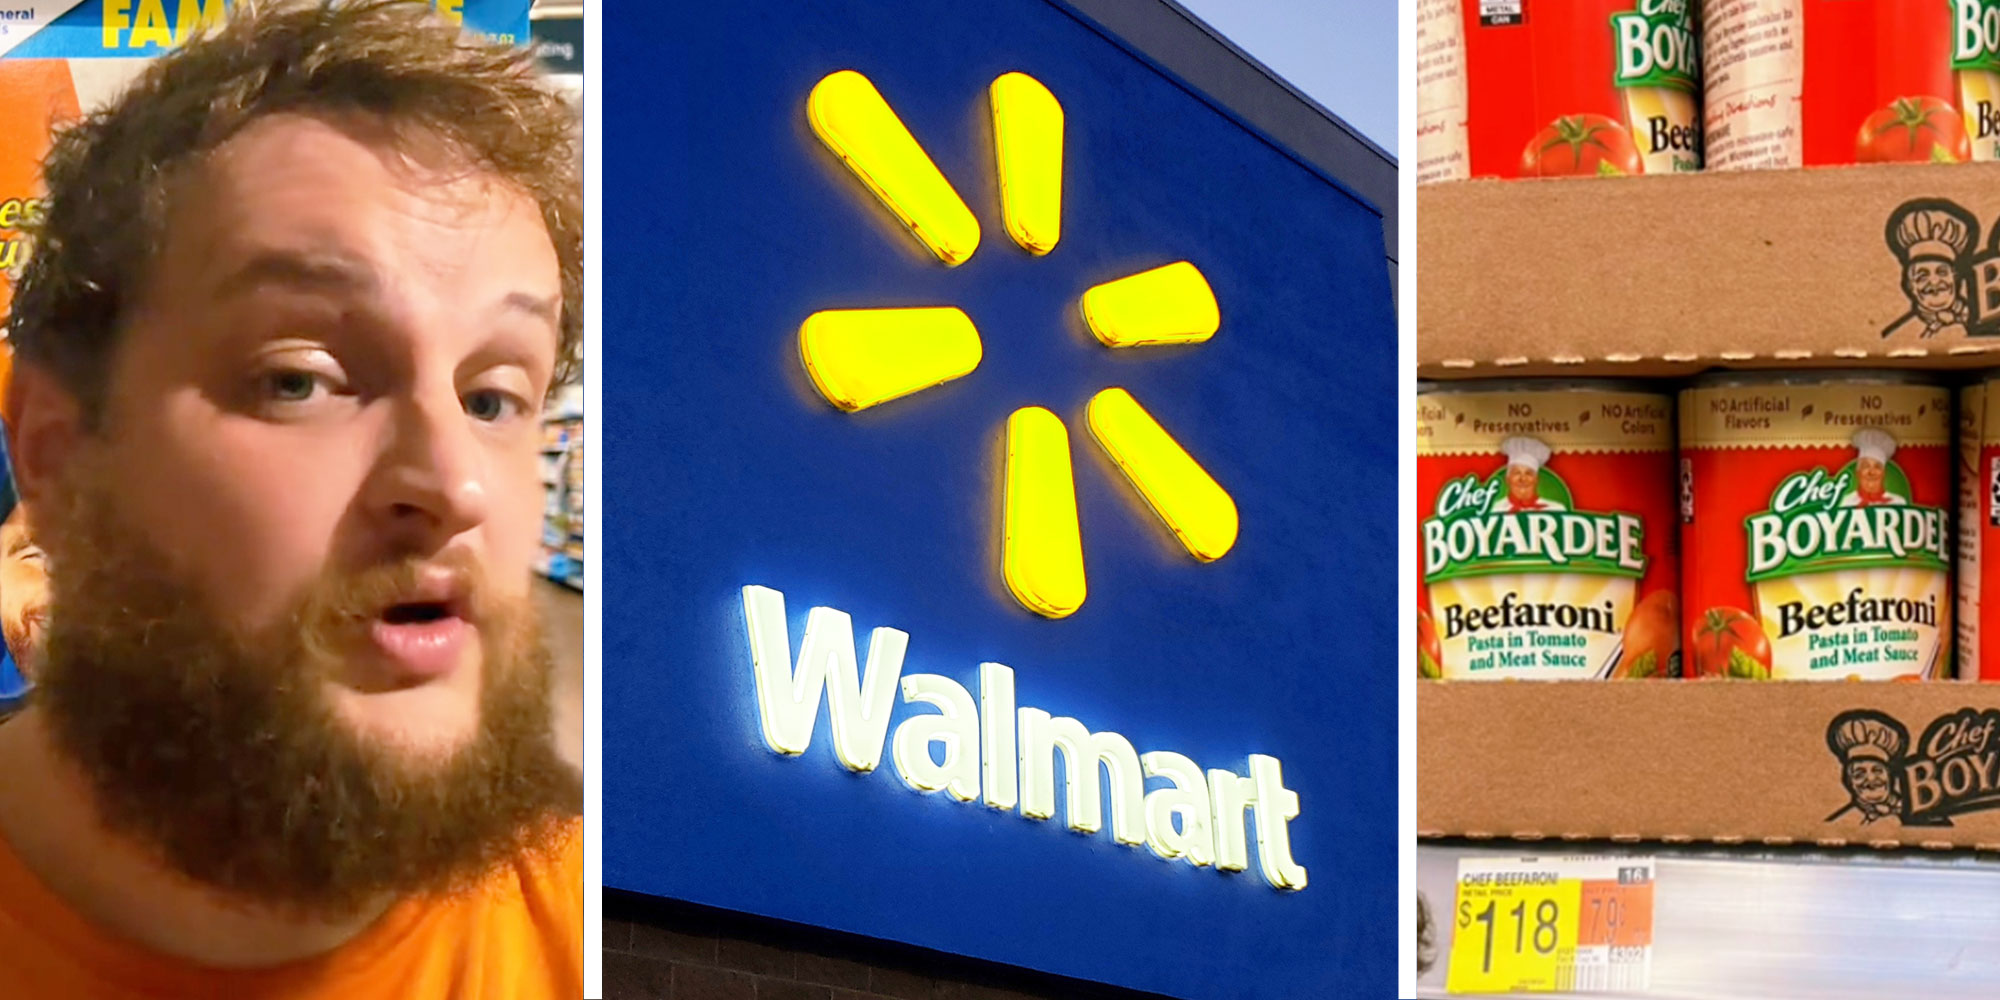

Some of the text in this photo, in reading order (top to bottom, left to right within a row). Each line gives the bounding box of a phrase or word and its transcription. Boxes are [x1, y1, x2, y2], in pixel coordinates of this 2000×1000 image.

[1508, 403, 1532, 417] NO
[1602, 404, 1622, 418] NO
[1711, 396, 1790, 413] NO Artificial
[1861, 395, 1882, 410] NO
[1474, 418, 1570, 434] Preservatives
[1621, 420, 1655, 435] Colors
[1725, 415, 1770, 429] Flavors
[1824, 410, 1912, 426] Preservatives
[1439, 476, 1499, 517] Chef
[1774, 470, 1849, 512] Chef
[1424, 513, 1644, 575] BOYARDEE
[1751, 507, 1949, 573] BOYARDEE
[1444, 592, 1617, 640] Beefaroni
[1777, 588, 1936, 639] Beefaroni
[1468, 631, 1587, 652] Pasta in Tomato
[1808, 625, 1918, 650] Pasta in Tomato
[1469, 650, 1587, 671] and Meat Sauce
[1810, 644, 1919, 669] and Meat Sauce
[742, 584, 1308, 891] Walmart
[1927, 716, 1996, 757] Chef
[1463, 872, 1559, 887] CHEF BEEFARONI
[1625, 868, 1643, 881] 16
[1491, 889, 1513, 897] PRICE
